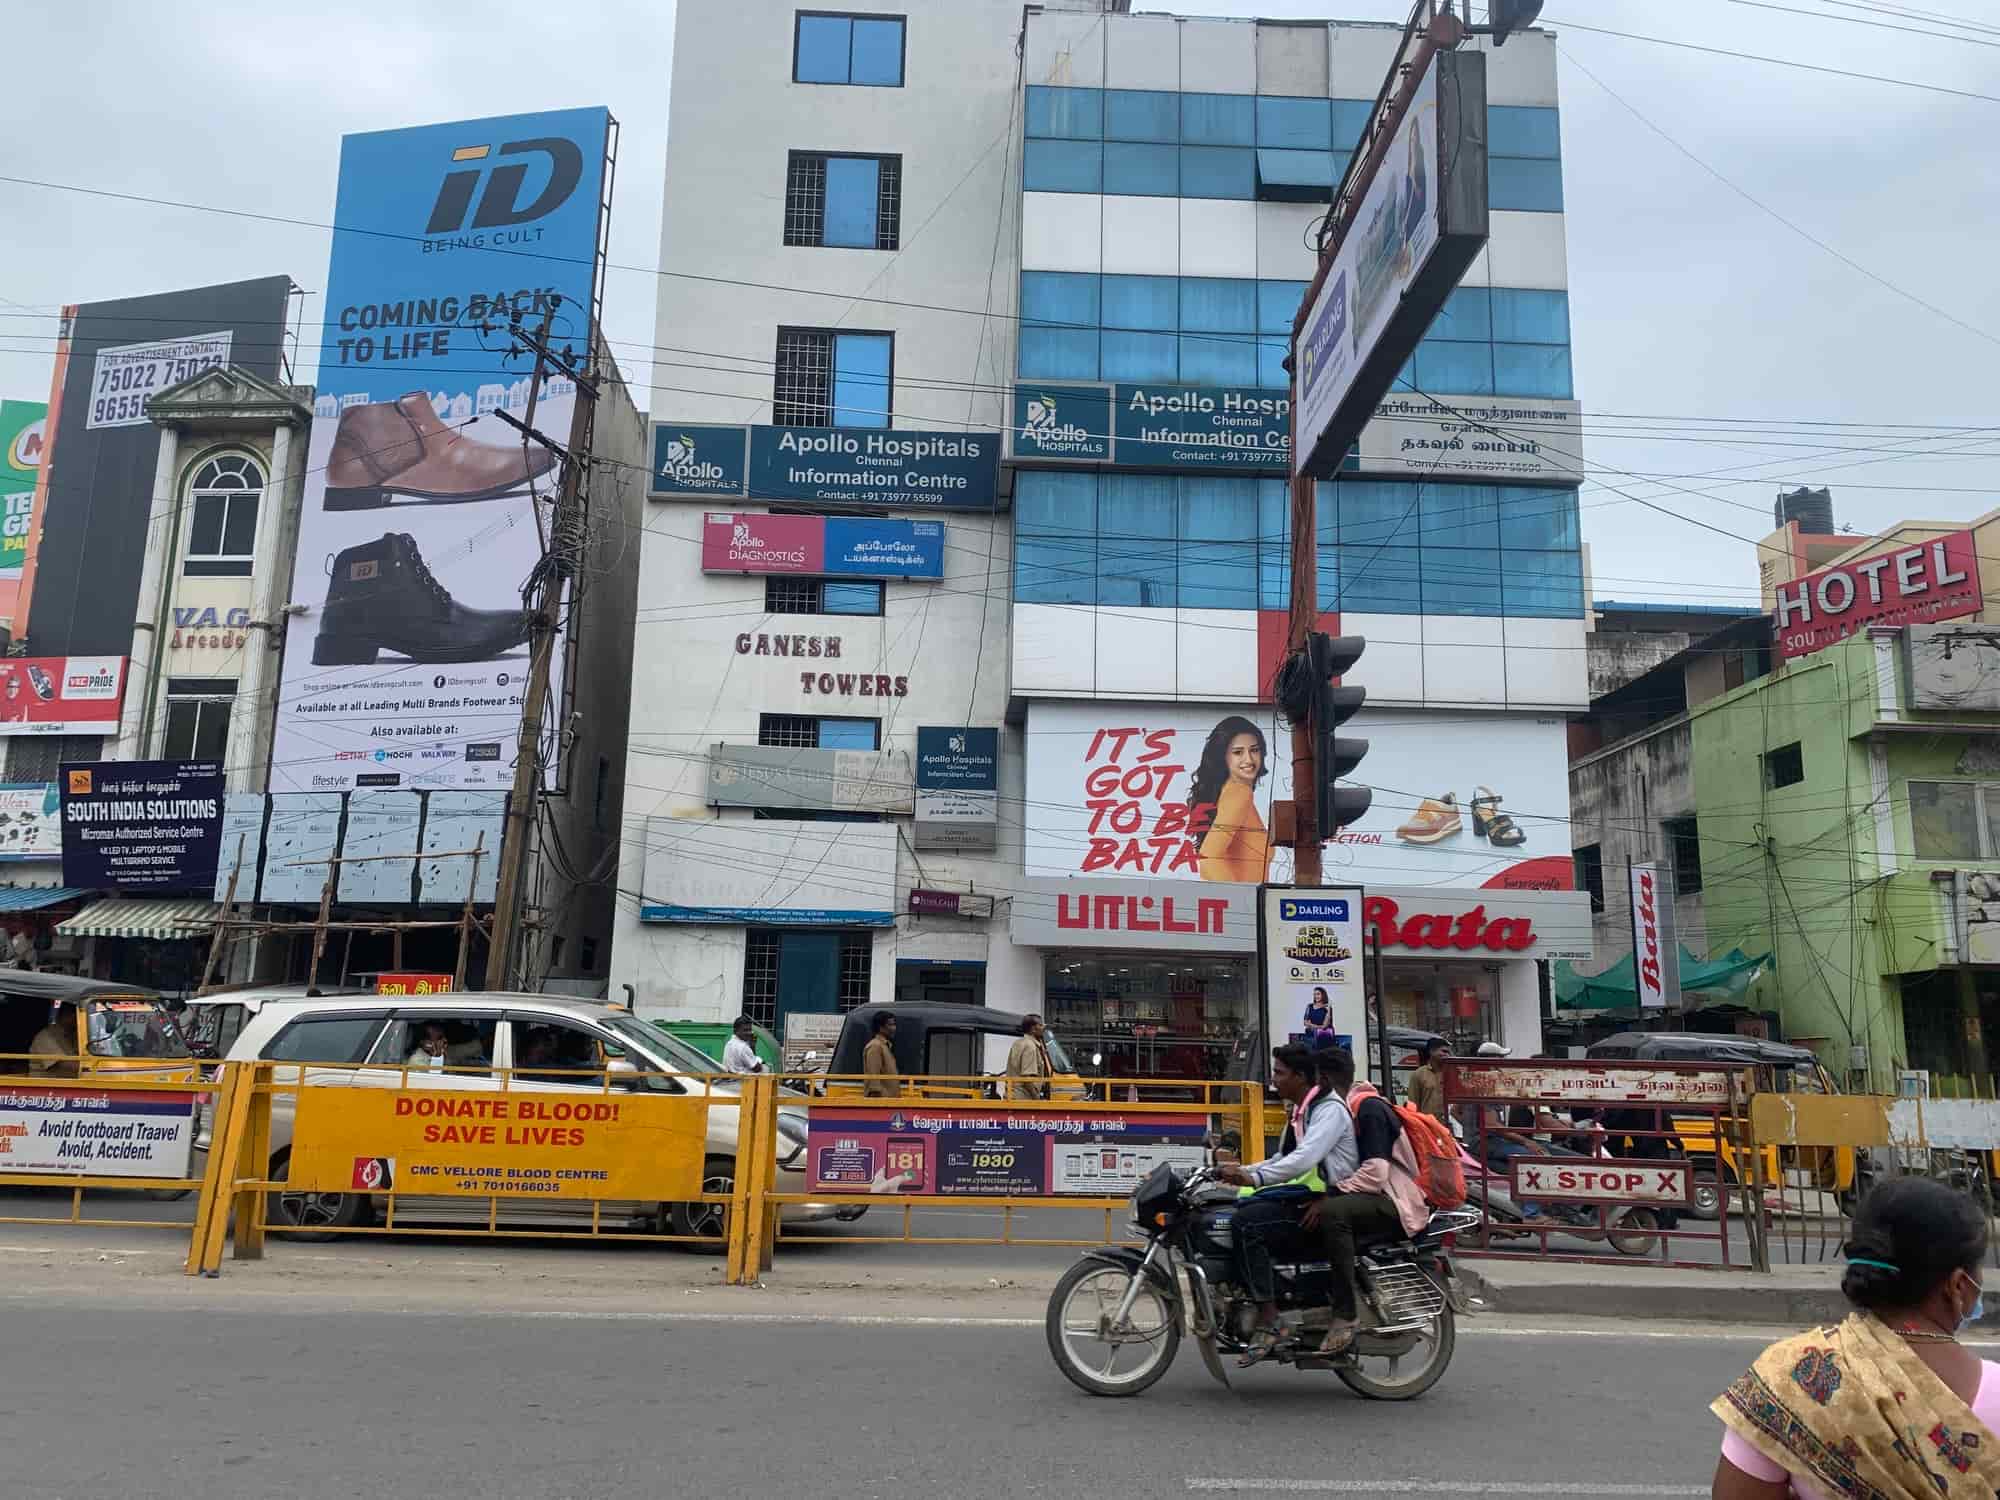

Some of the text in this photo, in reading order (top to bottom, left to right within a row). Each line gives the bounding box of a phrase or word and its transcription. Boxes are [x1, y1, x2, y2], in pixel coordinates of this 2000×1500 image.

[422, 227, 545, 253] BEING CULT
[340, 286, 556, 332] COMING BACK
[121, 346, 182, 365] ADVERTISEMENT
[337, 329, 451, 365] TO LIFE
[100, 363, 157, 393] 75022
[1129, 390, 1292, 420] Apollo Hosp
[1212, 415, 1263, 427] Chennai
[1021, 422, 1087, 447] Apollo
[1142, 427, 1292, 448] Information Ce
[778, 431, 980, 459] Apollo Hospitals
[1041, 442, 1103, 453] HOSPITALS
[1399, 436, 1465, 453] தகவல்
[855, 454, 904, 467] Chennai
[1172, 450, 1217, 461] Contact:
[1220, 452, 1240, 462] +91
[1240, 452, 1274, 463] 73977
[661, 460, 723, 484] Apollo
[788, 467, 968, 489] Information Centre
[679, 479, 738, 489] HOSPITALS
[816, 489, 943, 504] Contact: +91 73977 55599
[730, 537, 765, 551] Apollo
[729, 550, 805, 562] DIAGNOSTICS
[1776, 542, 1967, 629] HOTEL
[169, 629, 247, 649] Arcade
[735, 632, 843, 659] GANESH
[88, 674, 114, 688] PRIDE
[800, 671, 909, 698] TOWERS
[295, 695, 525, 714] Available at all Leading Multi Brands Footwear Sto
[371, 723, 459, 738] Also available at:
[421, 750, 457, 759] WALKWAY
[1084, 727, 1177, 763] IT'S
[386, 751, 413, 759] MOCHI
[923, 754, 993, 765] Apollo Hospitals
[312, 775, 349, 786] lifestyle
[927, 770, 964, 778] Information
[1085, 765, 1185, 801] GOT
[67, 798, 217, 822] SOUTH INDIA SOLUTIONS
[1085, 799, 1218, 837] TO BE
[115, 826, 152, 840] Authorized
[153, 825, 179, 839] Service
[180, 824, 205, 838] Centre
[132, 845, 155, 855] LAPTOP
[162, 844, 187, 854] MOBILE
[1080, 838, 1209, 874] BATA
[150, 855, 176, 865] SERVICE
[1057, 893, 1230, 934] பாட்டா
[1298, 905, 1344, 916] DARLING
[1364, 895, 1538, 951] Bata
[1296, 935, 1339, 947] MOBILE
[1641, 869, 1662, 997] Bata
[1283, 945, 1353, 959] THIRUVIZHA
[72, 1093, 110, 1109] காவல்
[395, 1097, 619, 1122] DONATE BLOOD!
[38, 1119, 73, 1138] Avoid
[74, 1120, 133, 1140] footboard
[136, 1122, 180, 1141] Traavel
[912, 1113, 1127, 1135] வேலூர் மாவட்ட போக்குவரத்து காவல்
[423, 1125, 585, 1146] SAVE LIVES
[57, 1140, 153, 1161] Avoid, Accident.
[887, 1152, 923, 1169] 181
[972, 1153, 1015, 1168] 1930
[410, 1165, 609, 1181] CMC VELLORE BLOOD CENTRE
[1557, 1172, 1644, 1192] STOP
[1656, 1170, 1679, 1194] X
[455, 1180, 561, 1194] +91 7010166035
